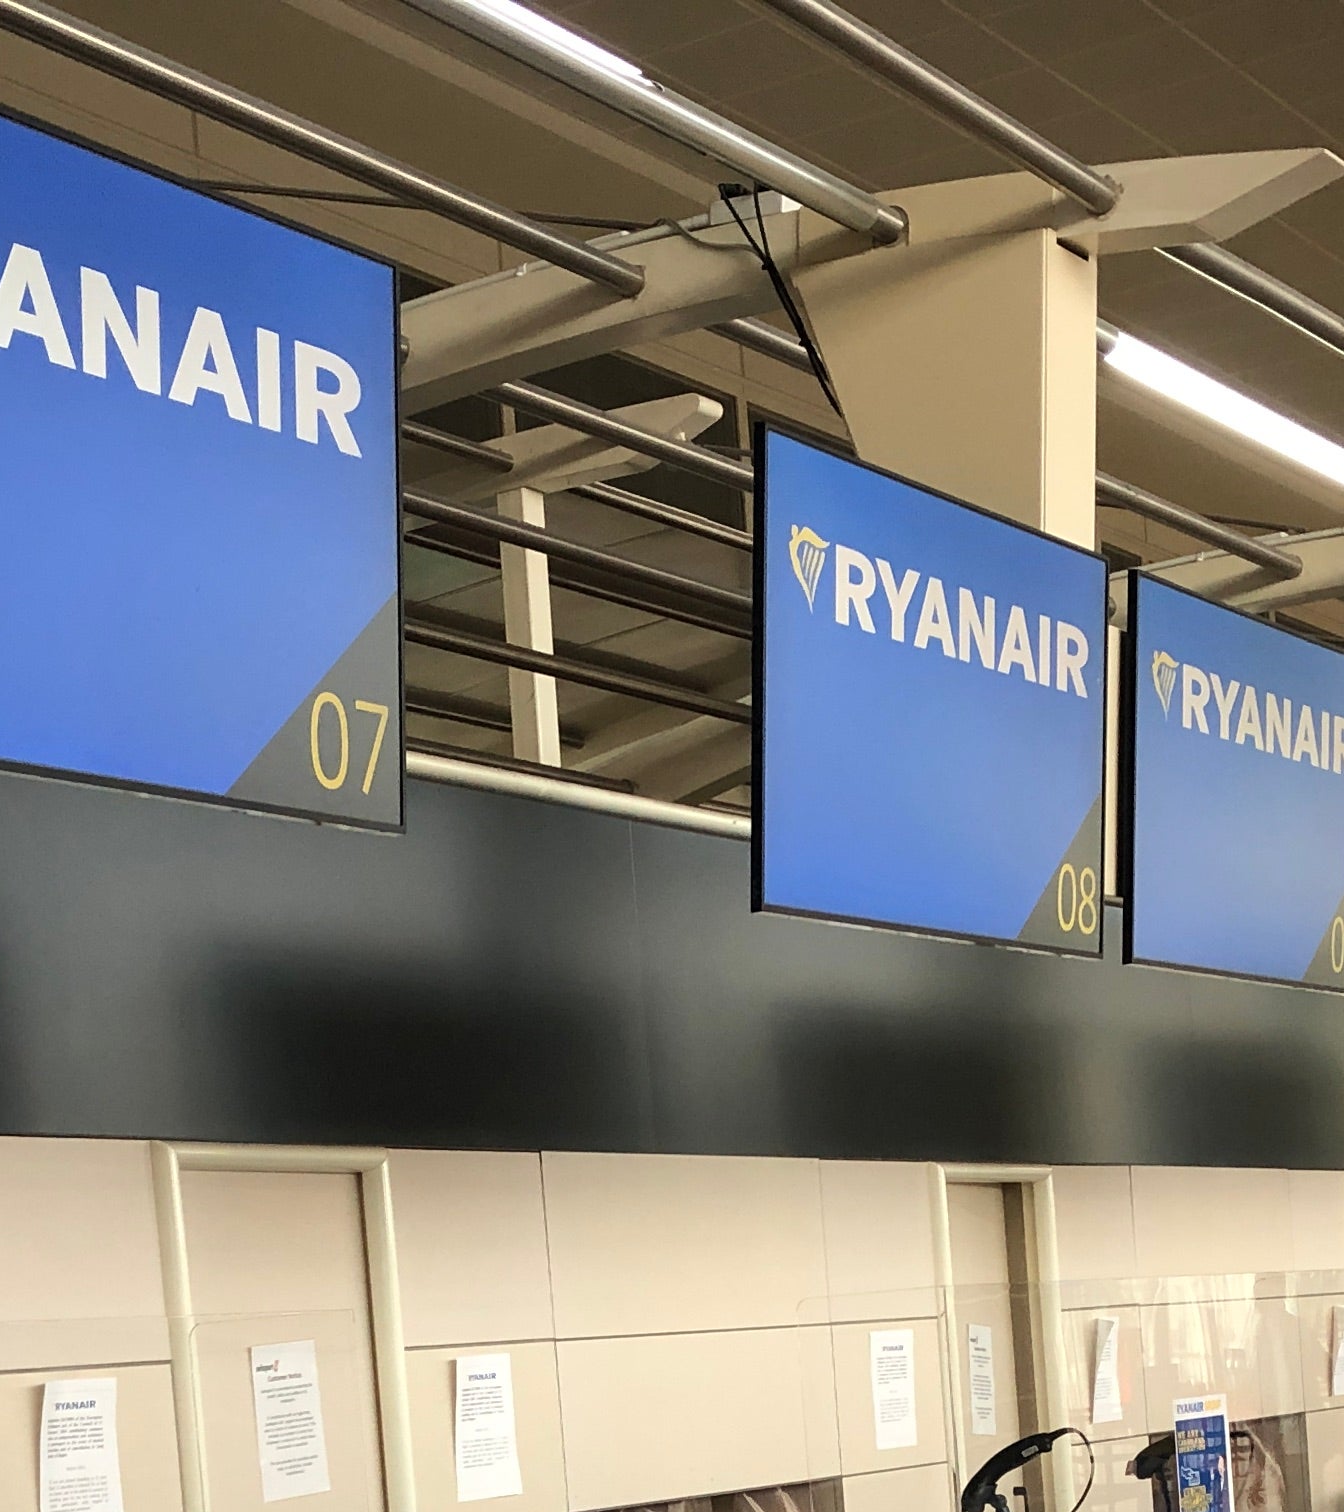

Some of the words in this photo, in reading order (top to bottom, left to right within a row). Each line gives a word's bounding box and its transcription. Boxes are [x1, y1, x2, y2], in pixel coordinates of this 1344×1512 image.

[834, 543, 1089, 699] RYANAIR
[309, 691, 391, 795] 07
[1057, 863, 1097, 935] 08
[55, 1400, 96, 1411] RYANAIR
